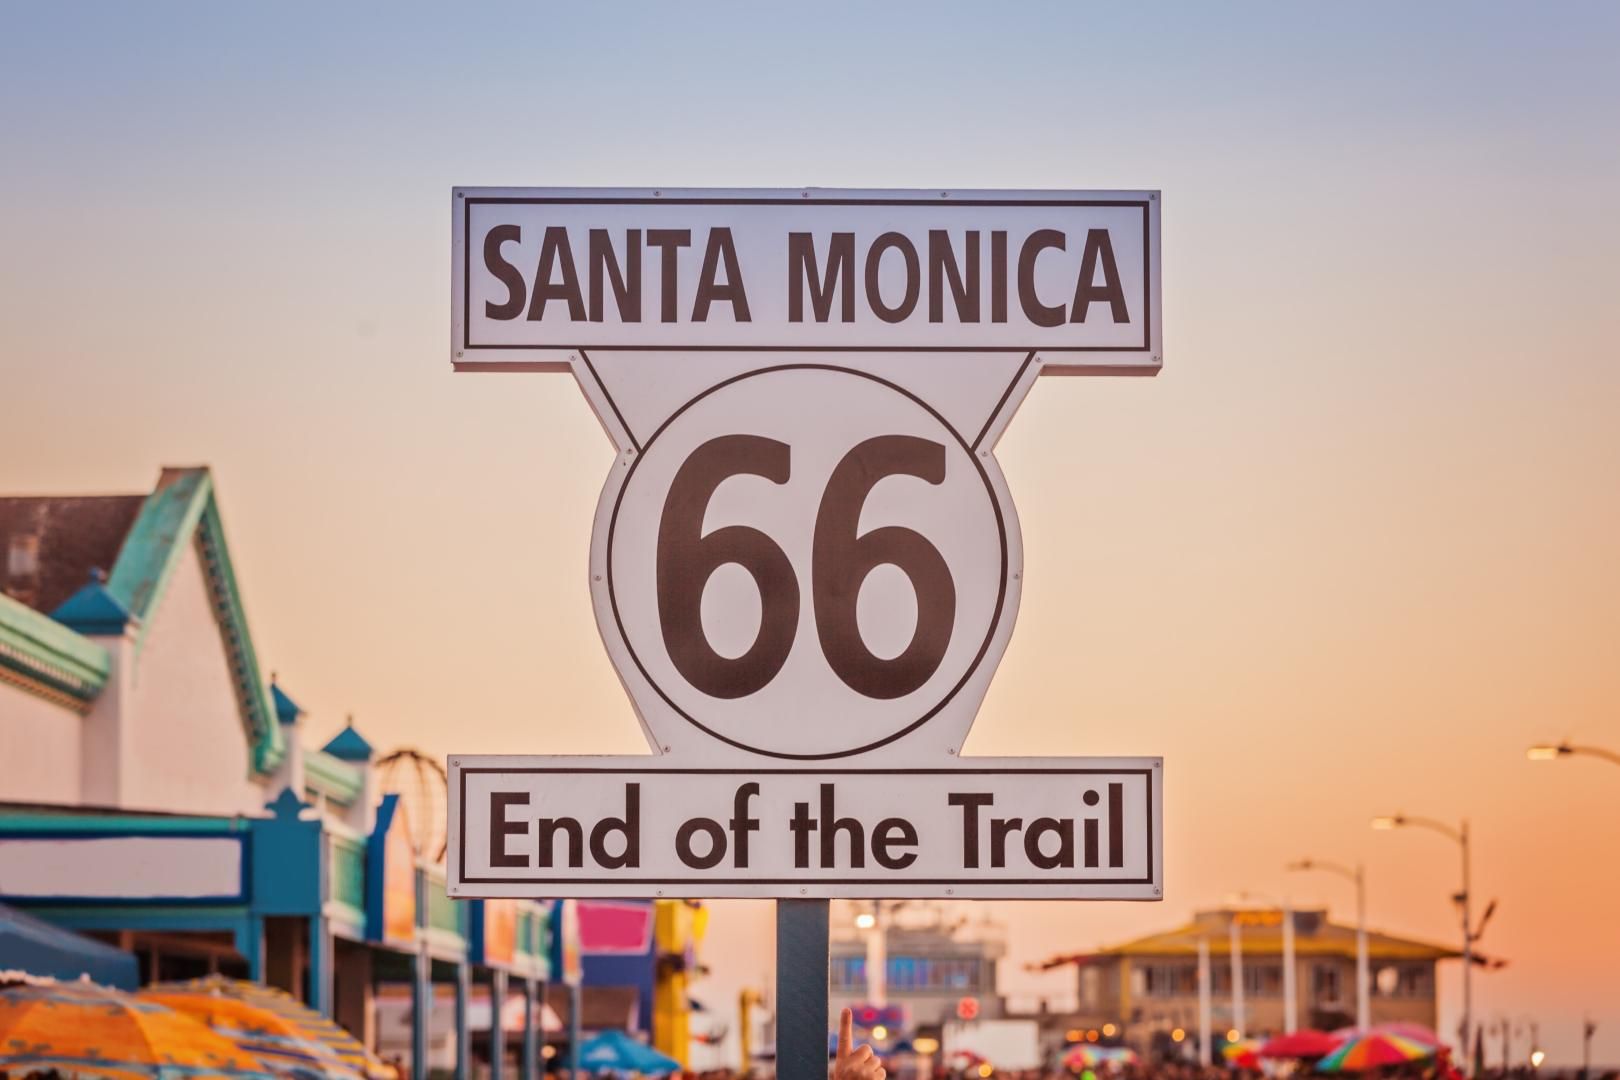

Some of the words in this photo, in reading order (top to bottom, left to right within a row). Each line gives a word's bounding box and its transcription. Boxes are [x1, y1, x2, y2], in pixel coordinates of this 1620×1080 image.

[484, 225, 752, 323] SANTA
[789, 229, 1131, 327] MONICA
[656, 433, 957, 700] 66
[489, 783, 641, 870] End
[675, 781, 760, 870] of
[789, 783, 919, 870] the
[947, 782, 1124, 870] Trail
